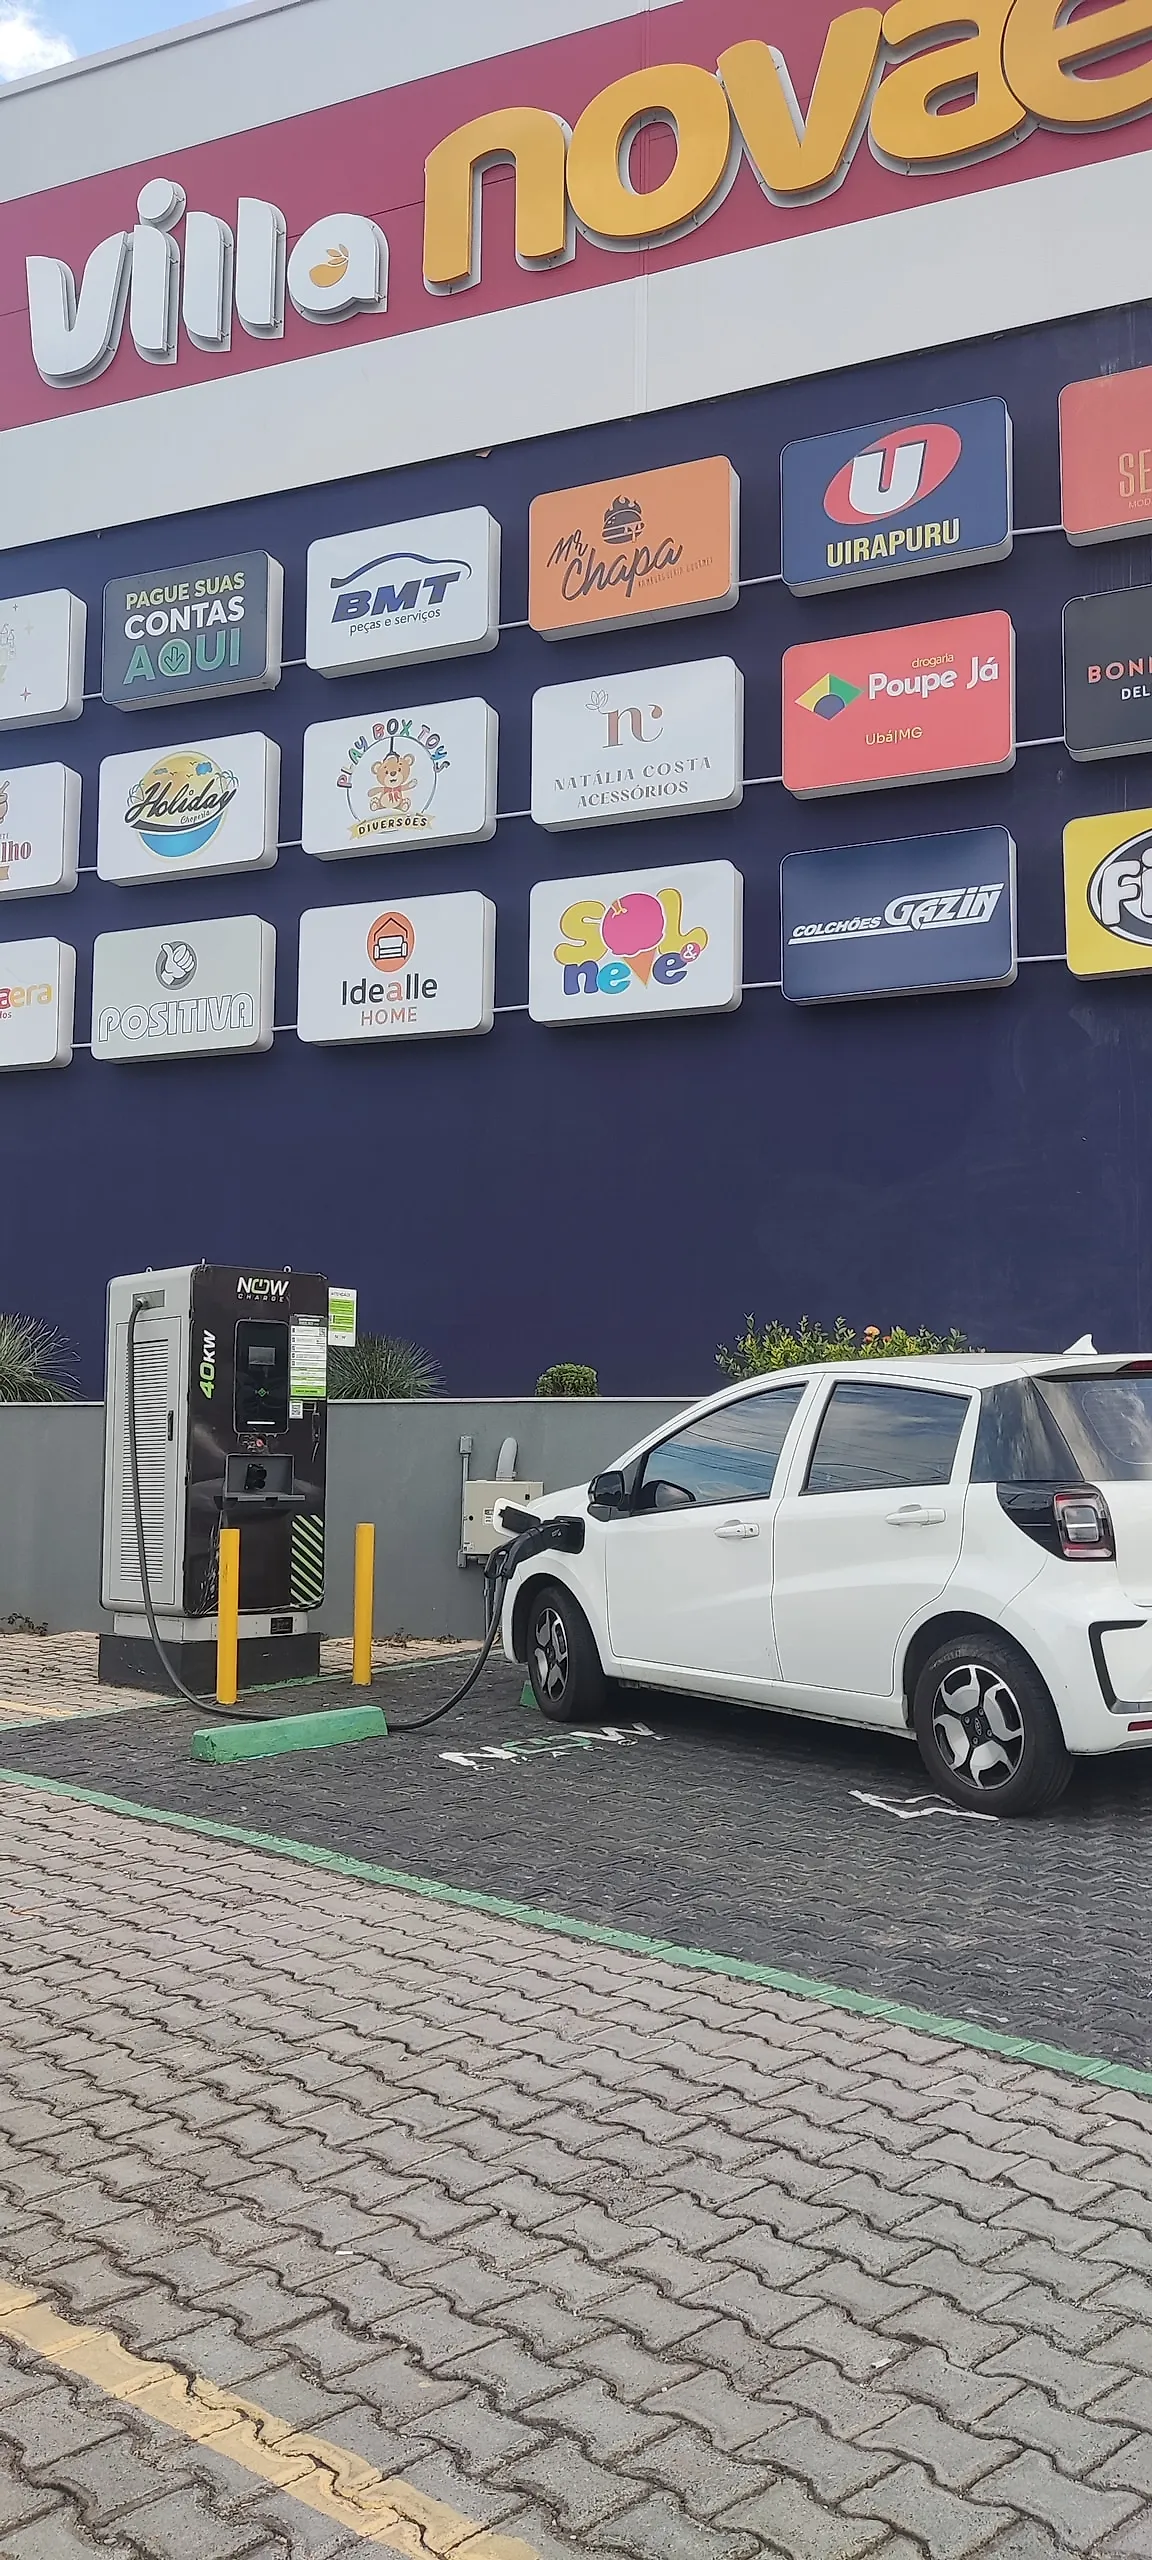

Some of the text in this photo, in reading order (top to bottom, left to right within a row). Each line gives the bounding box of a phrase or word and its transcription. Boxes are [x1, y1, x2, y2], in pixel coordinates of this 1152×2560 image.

[848, 441, 928, 515] U
[546, 529, 588, 568] Mr
[826, 518, 960, 568] UIRAPURU
[561, 537, 683, 601] Chapa
[126, 572, 245, 611] PAGUE SUAS
[331, 571, 462, 624] BMT
[124, 595, 245, 640] CONTAS
[349, 607, 442, 637] peças e serviços
[123, 627, 241, 685] AQUI
[911, 653, 955, 670] drogaria
[1087, 656, 1152, 684] BON
[868, 656, 999, 700] Poupe Já
[337, 718, 451, 788] PLAY BOX TOYS
[554, 756, 712, 792] NATÁLIA COSTA
[125, 778, 237, 823] Holiday
[577, 781, 689, 808] ACESSÓRIOS
[358, 815, 428, 835] DIVERSÕES
[792, 883, 1005, 938] COLCHÕES GAZIN
[341, 972, 438, 1006] Idealle
[99, 992, 254, 1042] POSITIVA
[360, 1006, 418, 1027] HOME
[237, 1276, 290, 1296] NOW
[237, 1293, 285, 1303] CHARGE
